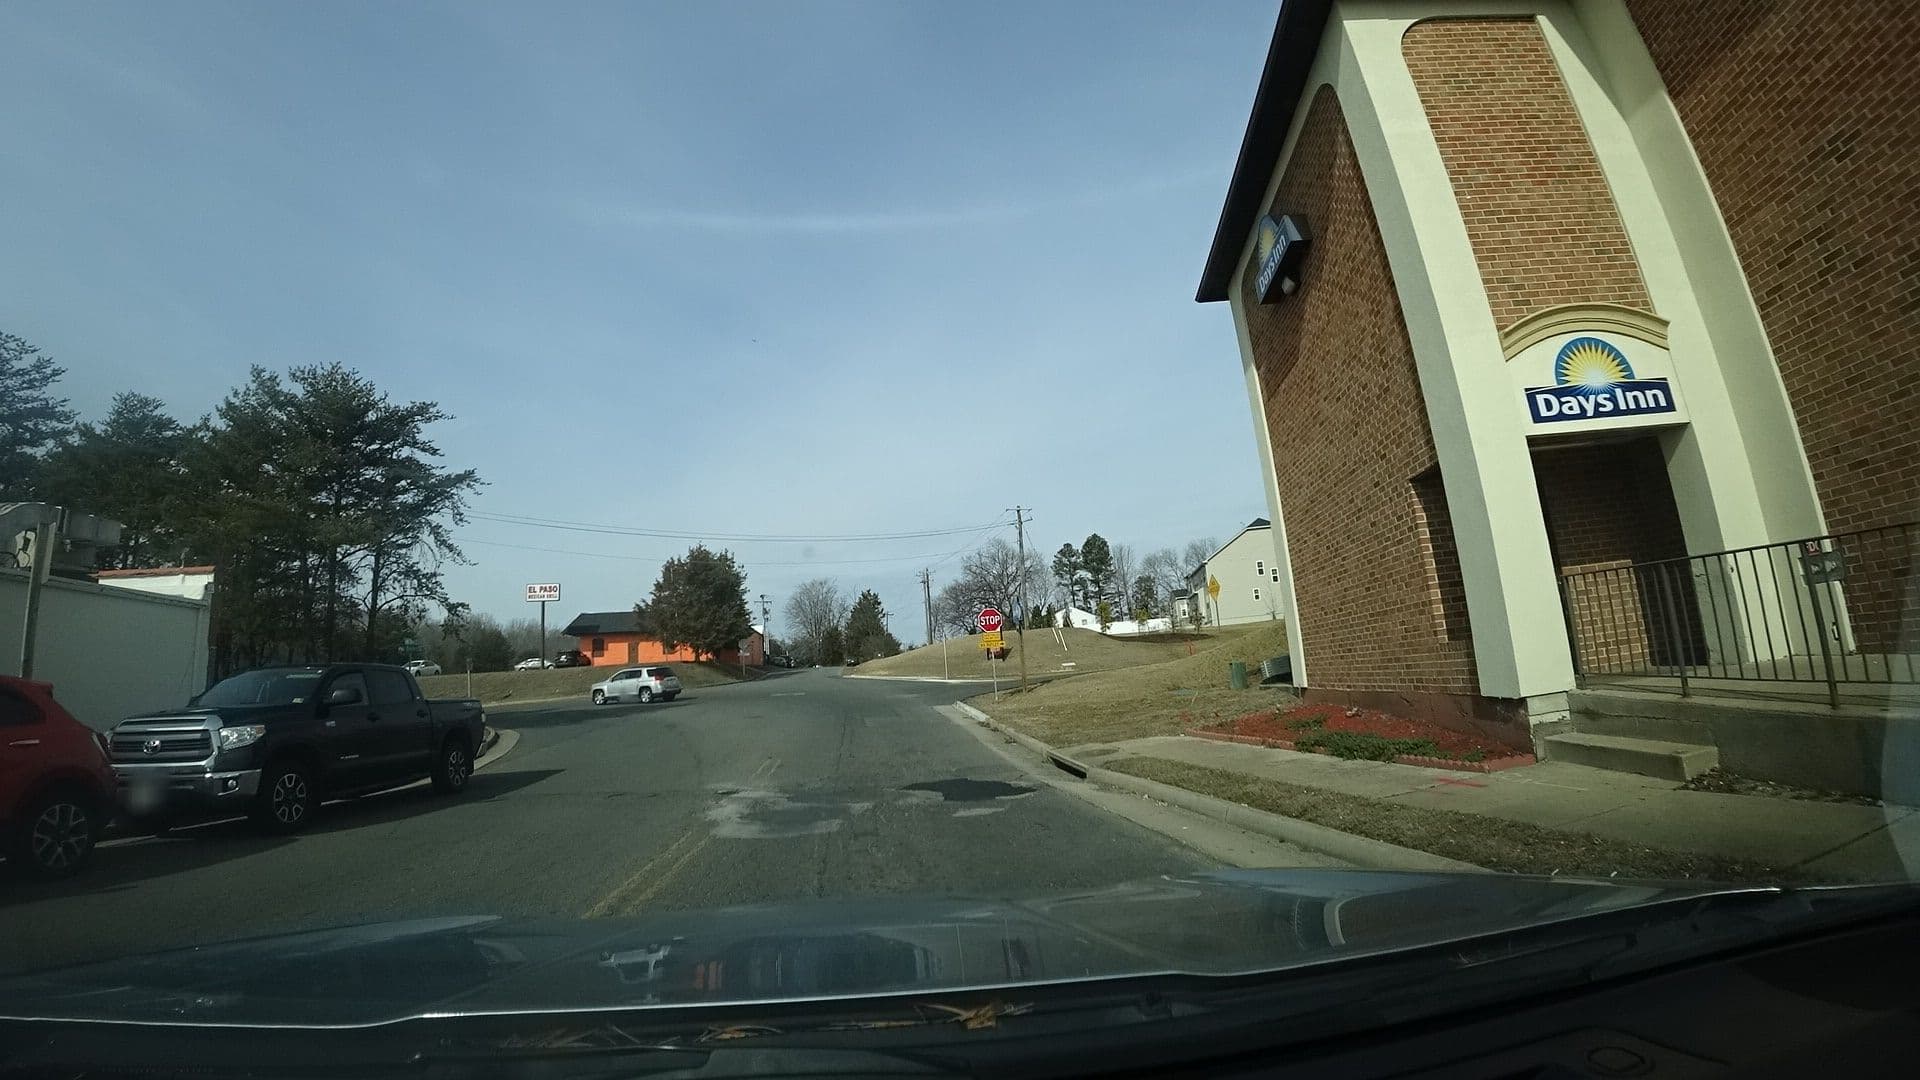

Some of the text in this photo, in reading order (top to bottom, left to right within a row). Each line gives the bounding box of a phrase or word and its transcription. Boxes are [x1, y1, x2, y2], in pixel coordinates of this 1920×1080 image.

[1259, 235, 1286, 292] Days Inn
[1535, 388, 1667, 417] Days Inn
[539, 585, 558, 593] PASO
[980, 615, 1000, 626] STOP
